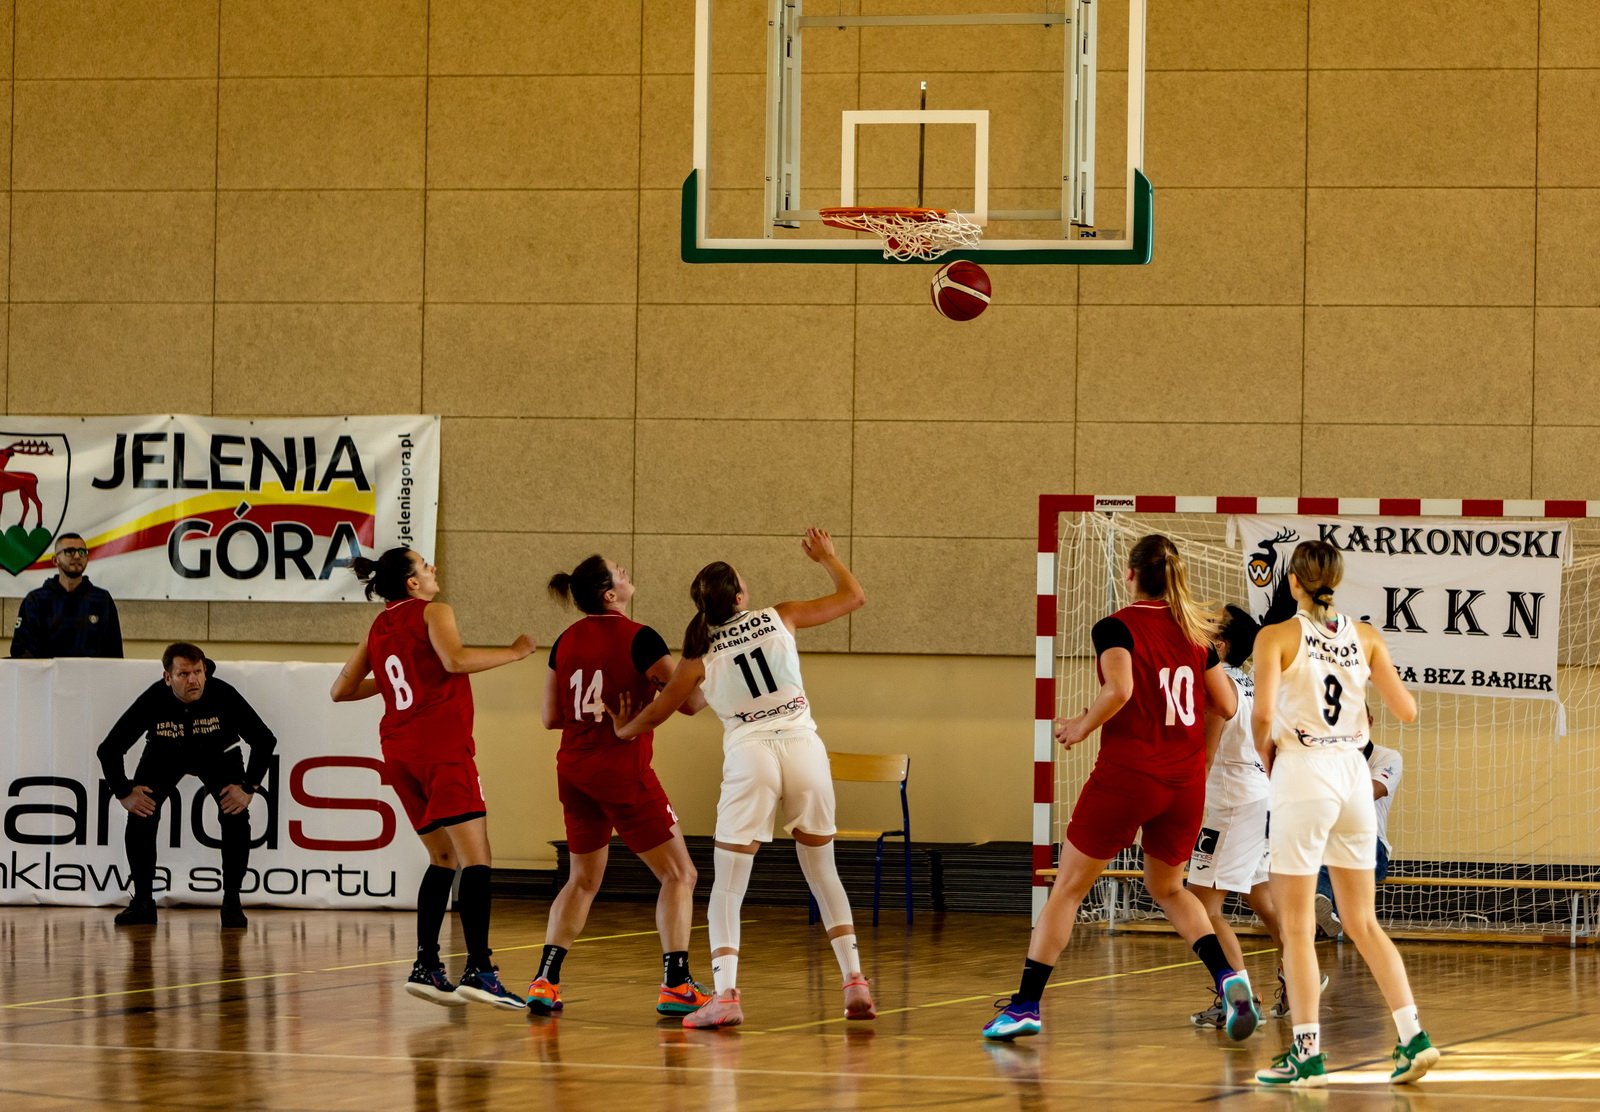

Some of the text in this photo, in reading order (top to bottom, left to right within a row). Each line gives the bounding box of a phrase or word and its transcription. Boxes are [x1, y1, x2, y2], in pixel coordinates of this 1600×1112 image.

[92, 433, 371, 492] JELENIA
[168, 501, 366, 580] GÓRA
[1317, 523, 1562, 559] KARKONOSKI
[1382, 587, 1545, 639] K K N
[713, 637, 750, 653] JELENIA
[385, 655, 413, 710] 8
[570, 669, 605, 722] 14
[733, 647, 778, 699] 11
[1159, 666, 1195, 726] 10
[1424, 668, 1466, 685] BEZ
[1471, 670, 1553, 692] BARIER
[1323, 674, 1342, 726] 9
